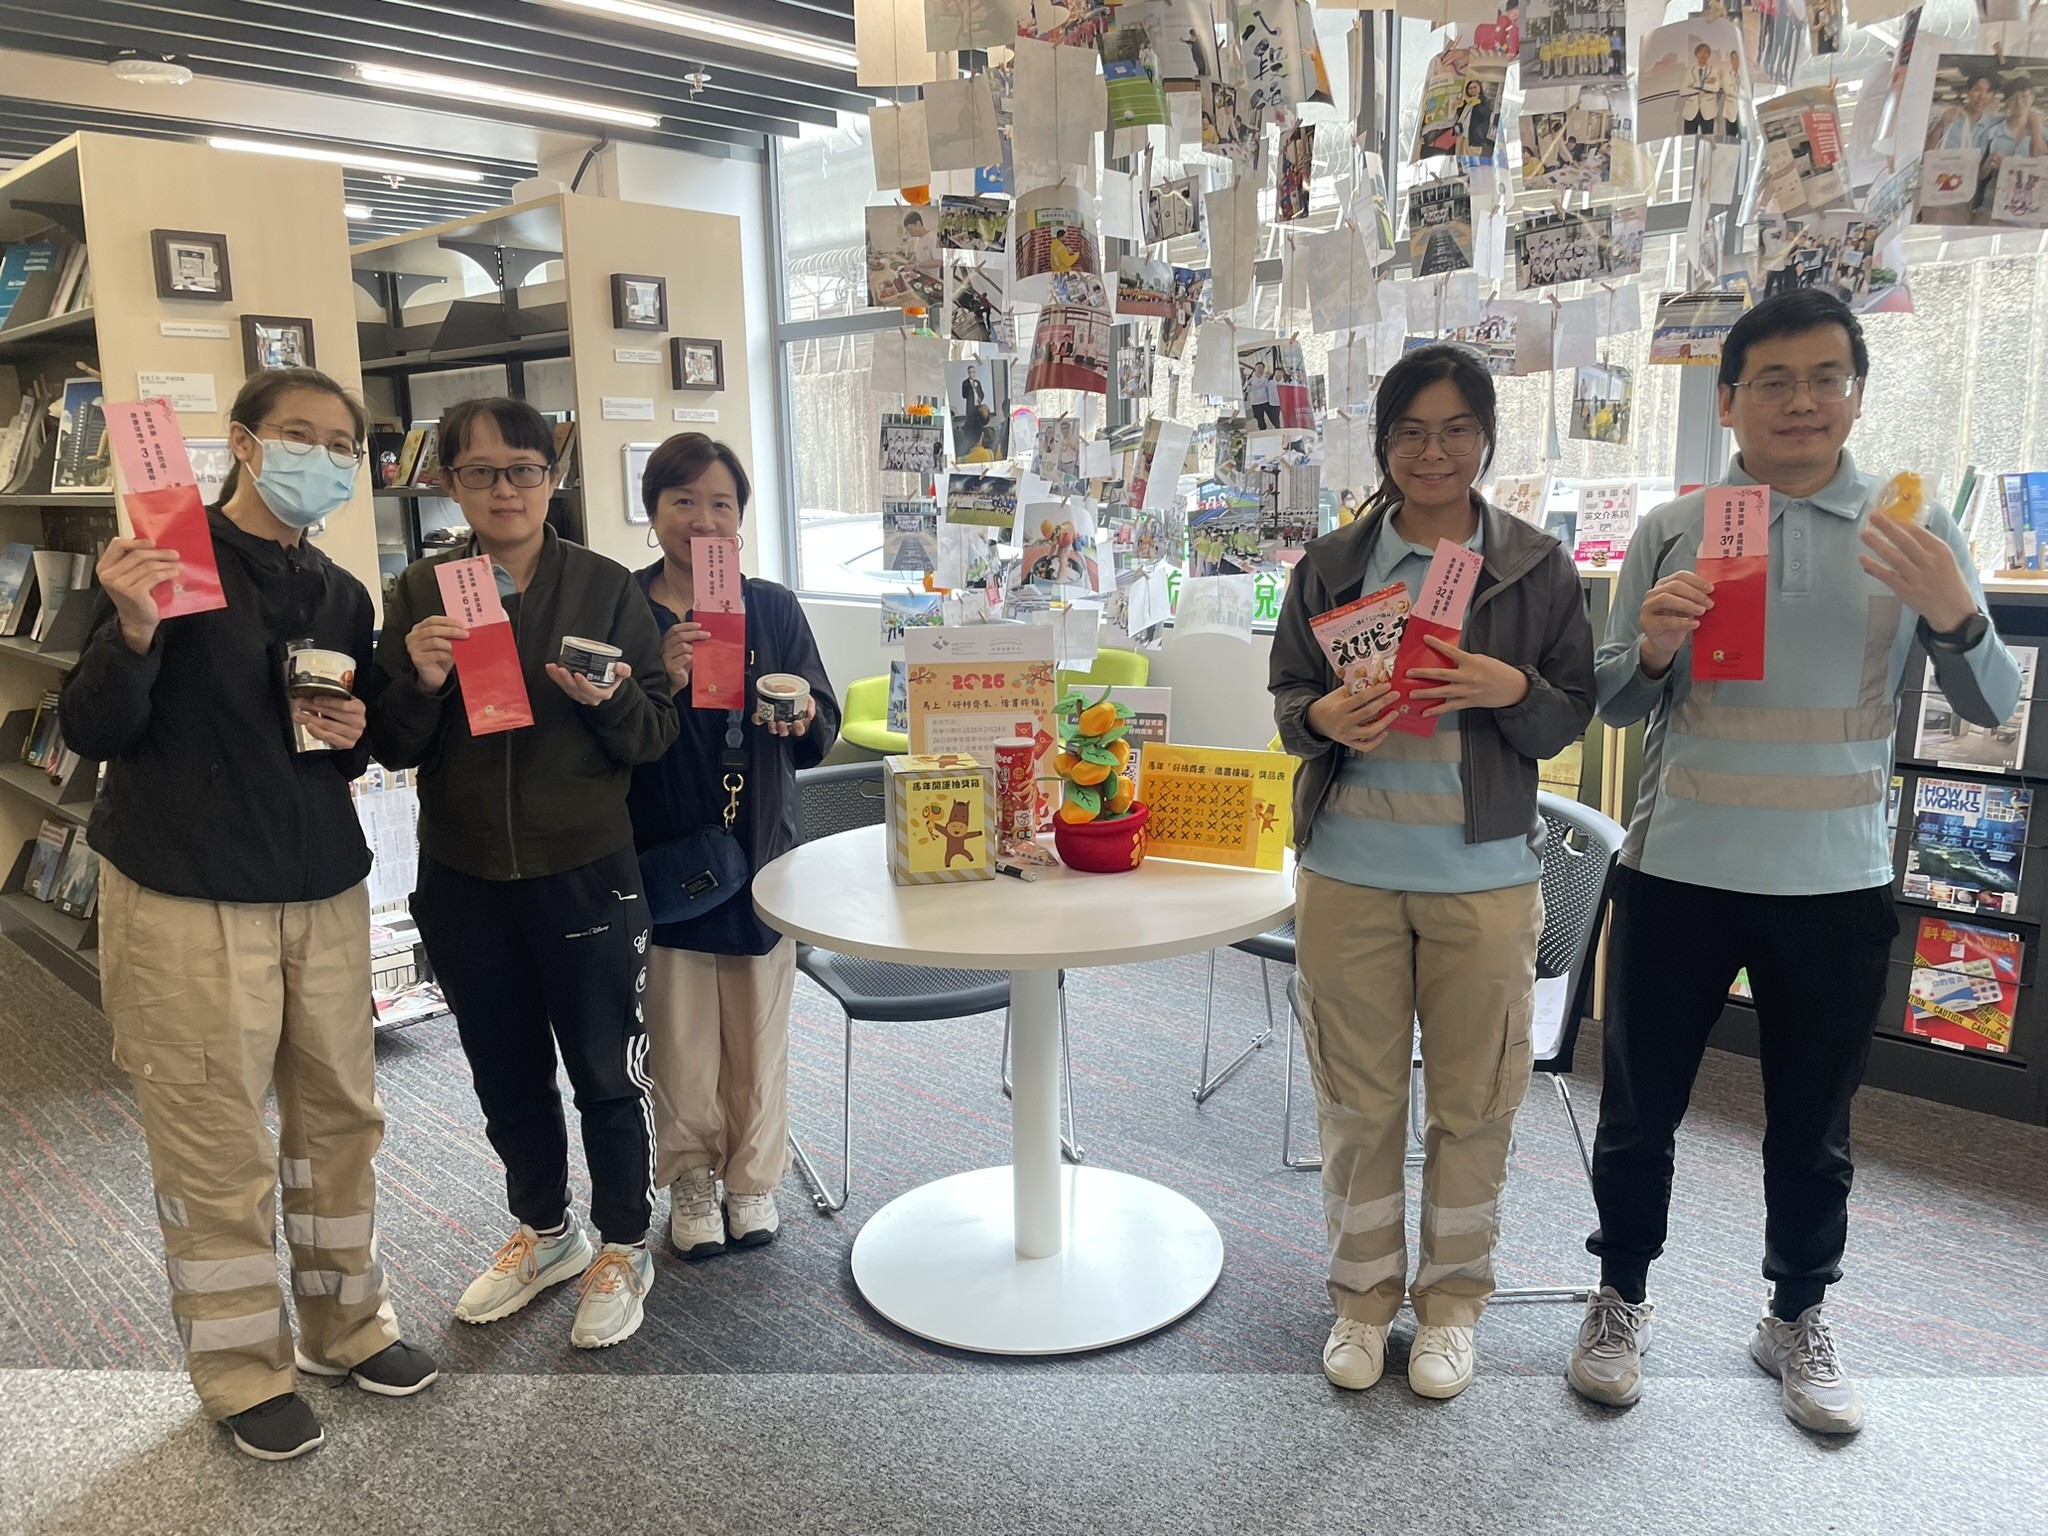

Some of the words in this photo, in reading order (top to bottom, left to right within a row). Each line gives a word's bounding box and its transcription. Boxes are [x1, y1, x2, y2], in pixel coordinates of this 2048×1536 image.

[1586, 489, 1631, 498] 最強圖解
[1584, 510, 1629, 520] 英文介系詞
[1720, 535, 1734, 546] 37
[1435, 586, 1447, 598] 32
[952, 673, 1005, 690] 2026
[1925, 785, 1962, 800] HOW
[1965, 790, 1982, 802] IT
[1925, 796, 1980, 813] WORKS
[1206, 834, 1215, 842] 38
[1934, 1006, 1964, 1024] CAUTION
[1971, 1022, 2002, 1041] CAUTION
